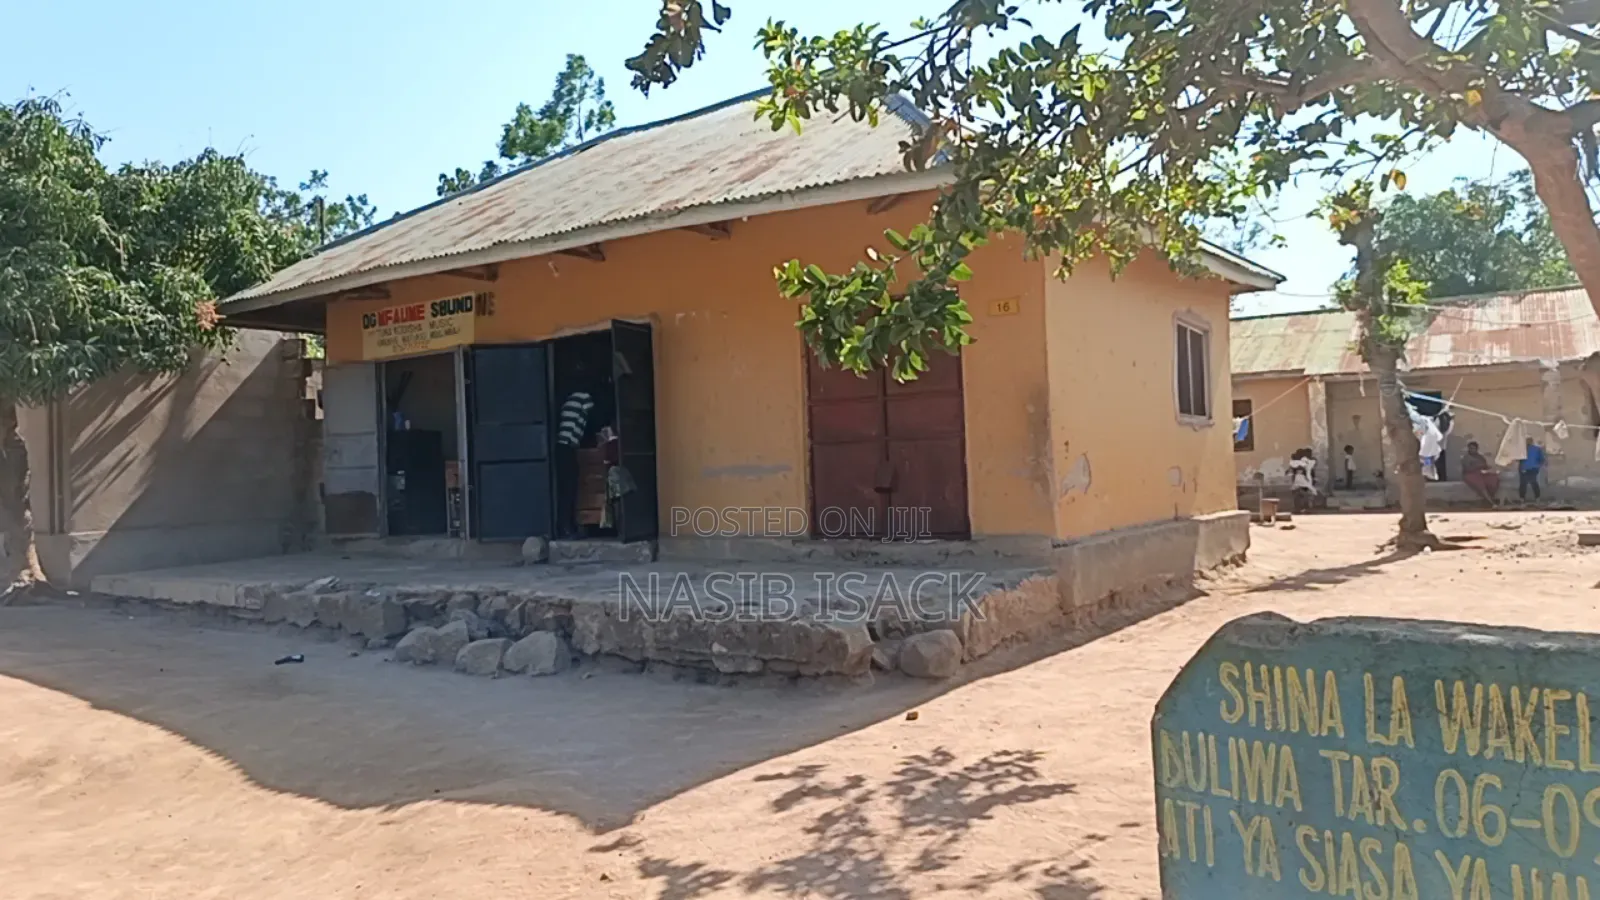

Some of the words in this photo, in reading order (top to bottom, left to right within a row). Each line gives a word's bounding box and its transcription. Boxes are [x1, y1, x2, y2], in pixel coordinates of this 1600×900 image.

[996, 301, 1010, 313] 16
[1218, 661, 1344, 739] SHINA
[1363, 672, 1415, 749] LA
[1229, 809, 1282, 882] YA
[1295, 824, 1419, 900] SIASA
